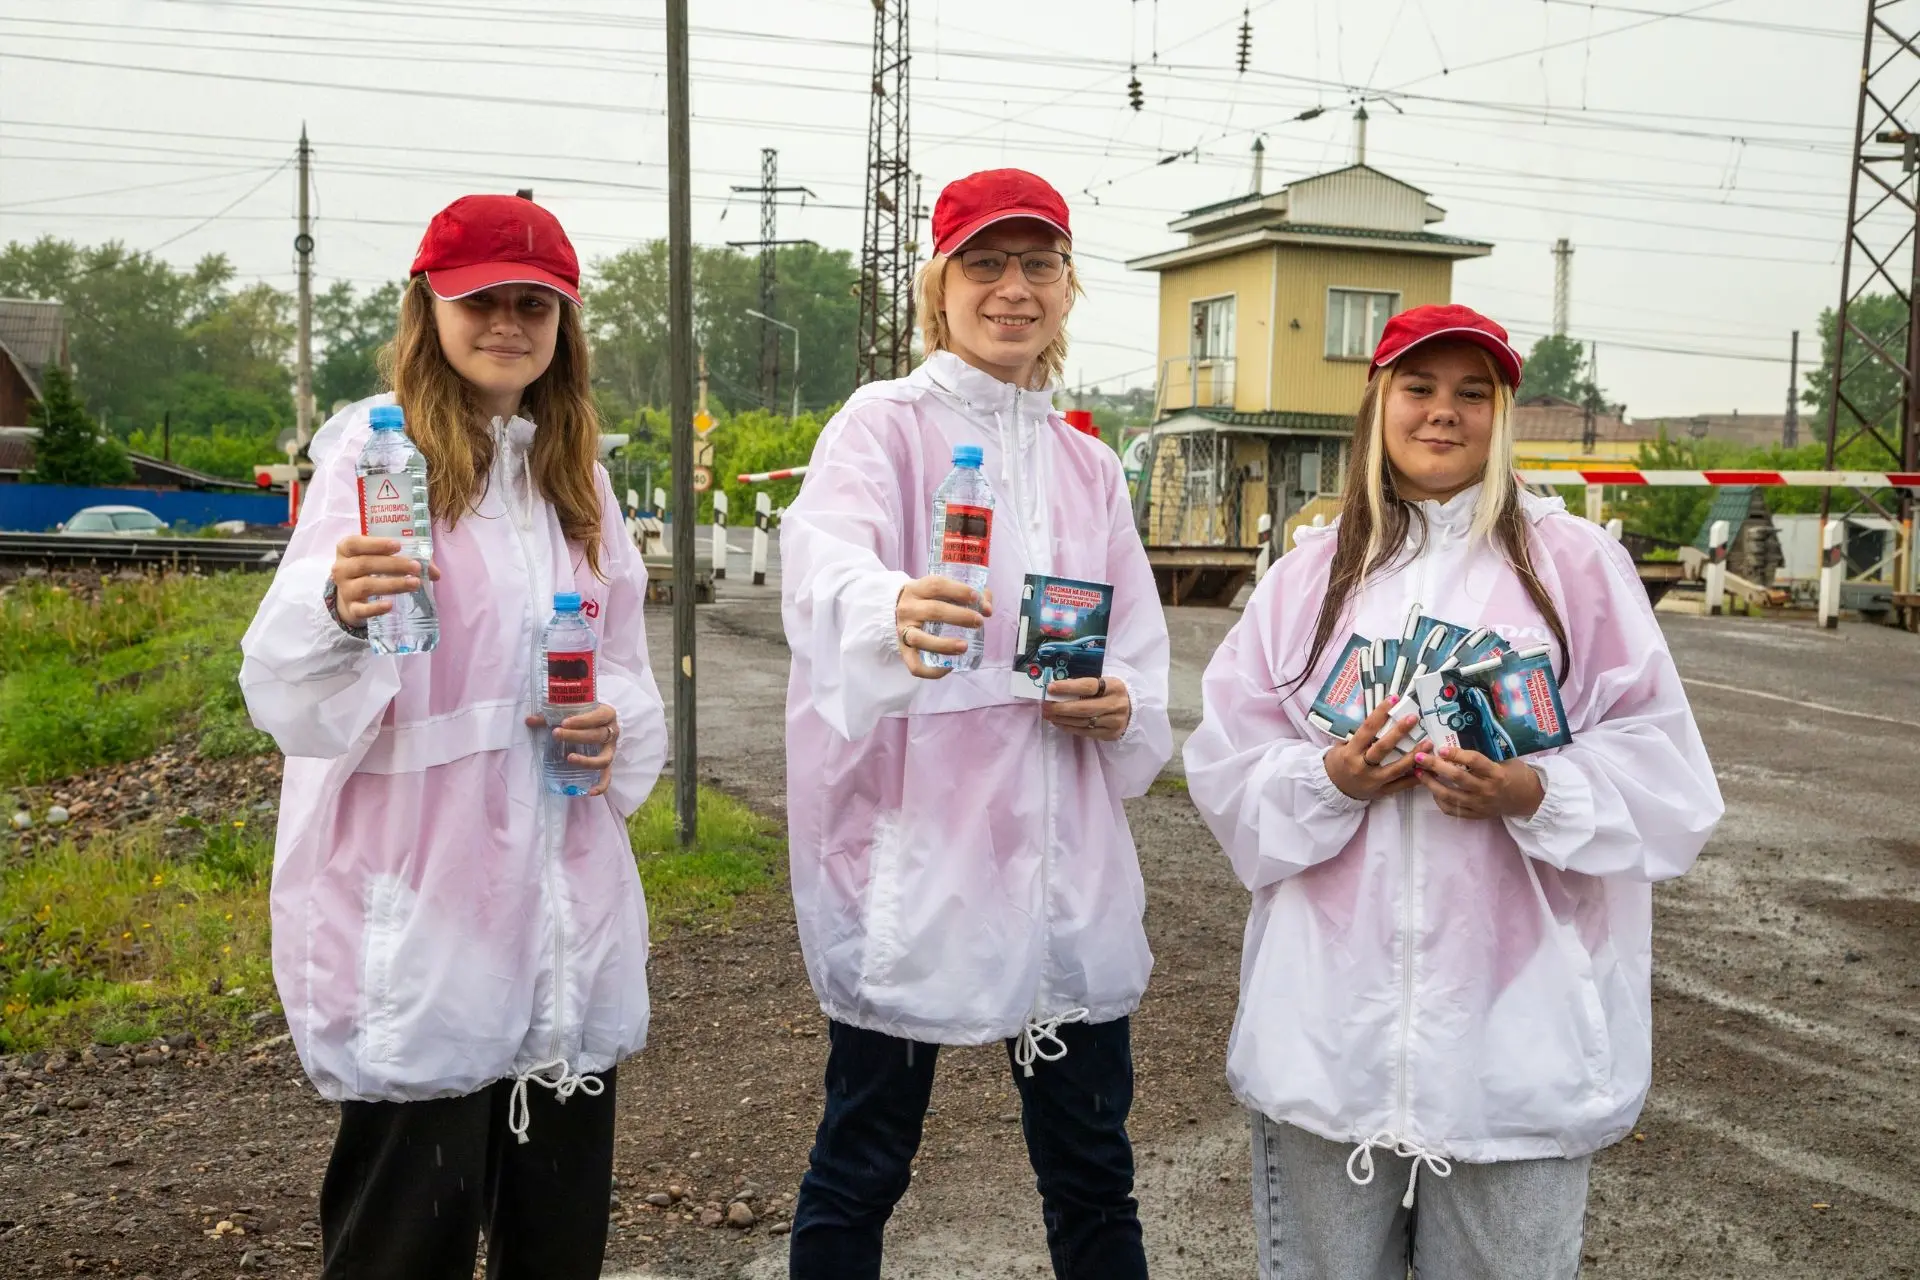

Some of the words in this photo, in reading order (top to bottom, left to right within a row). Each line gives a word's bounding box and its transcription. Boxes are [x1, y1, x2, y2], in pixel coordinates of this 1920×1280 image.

[1536, 669, 1550, 698] ВЫЕЗЖАЯ
[1544, 698, 1552, 707] НА
[1546, 707, 1559, 732] ПЕРЕЕЗД
